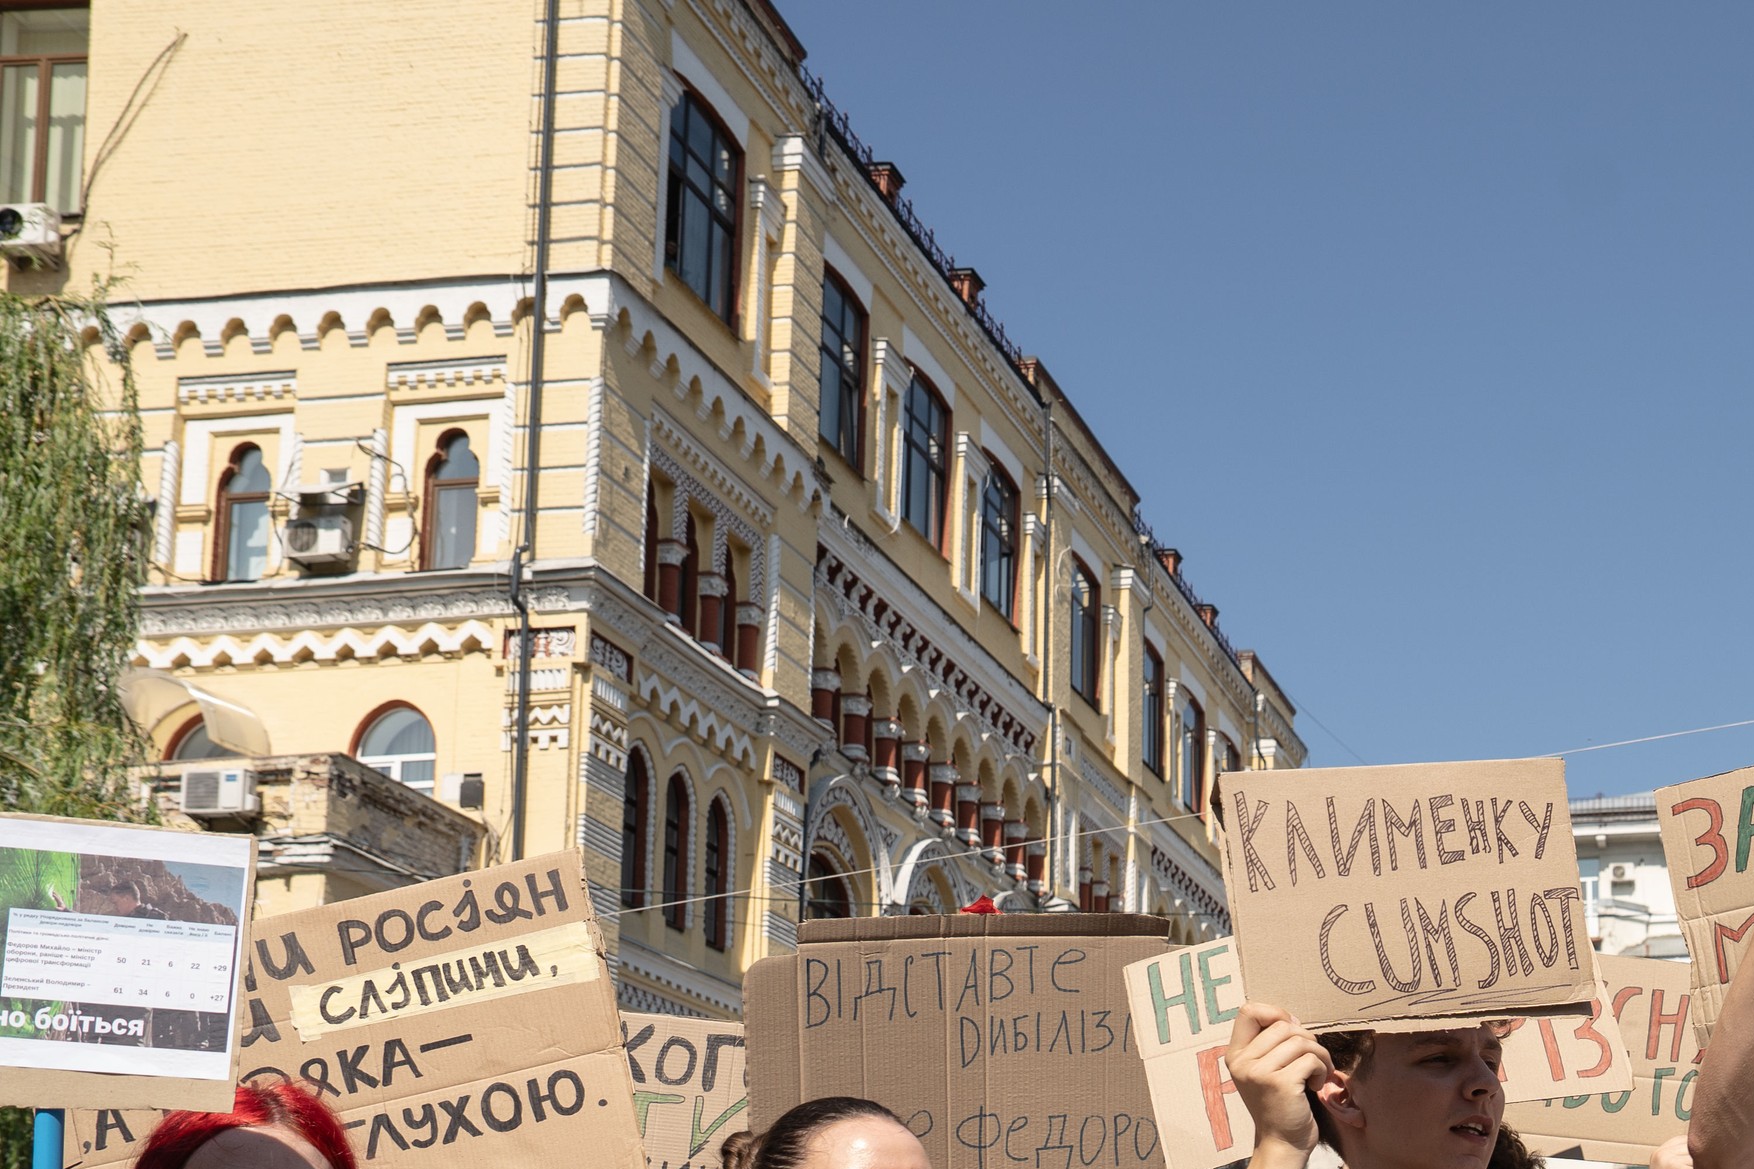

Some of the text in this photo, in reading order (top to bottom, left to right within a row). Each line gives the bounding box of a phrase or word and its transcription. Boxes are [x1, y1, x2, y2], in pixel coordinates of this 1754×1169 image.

[1234, 790, 1554, 892] КЛИМЕНКУ
[245, 931, 315, 992] И
[1319, 886, 1579, 996] CUMSHOT
[35, 1006, 145, 1037] боїться
[45, 978, 85, 988] Володимир
[1147, 944, 1241, 1045] НЕ
